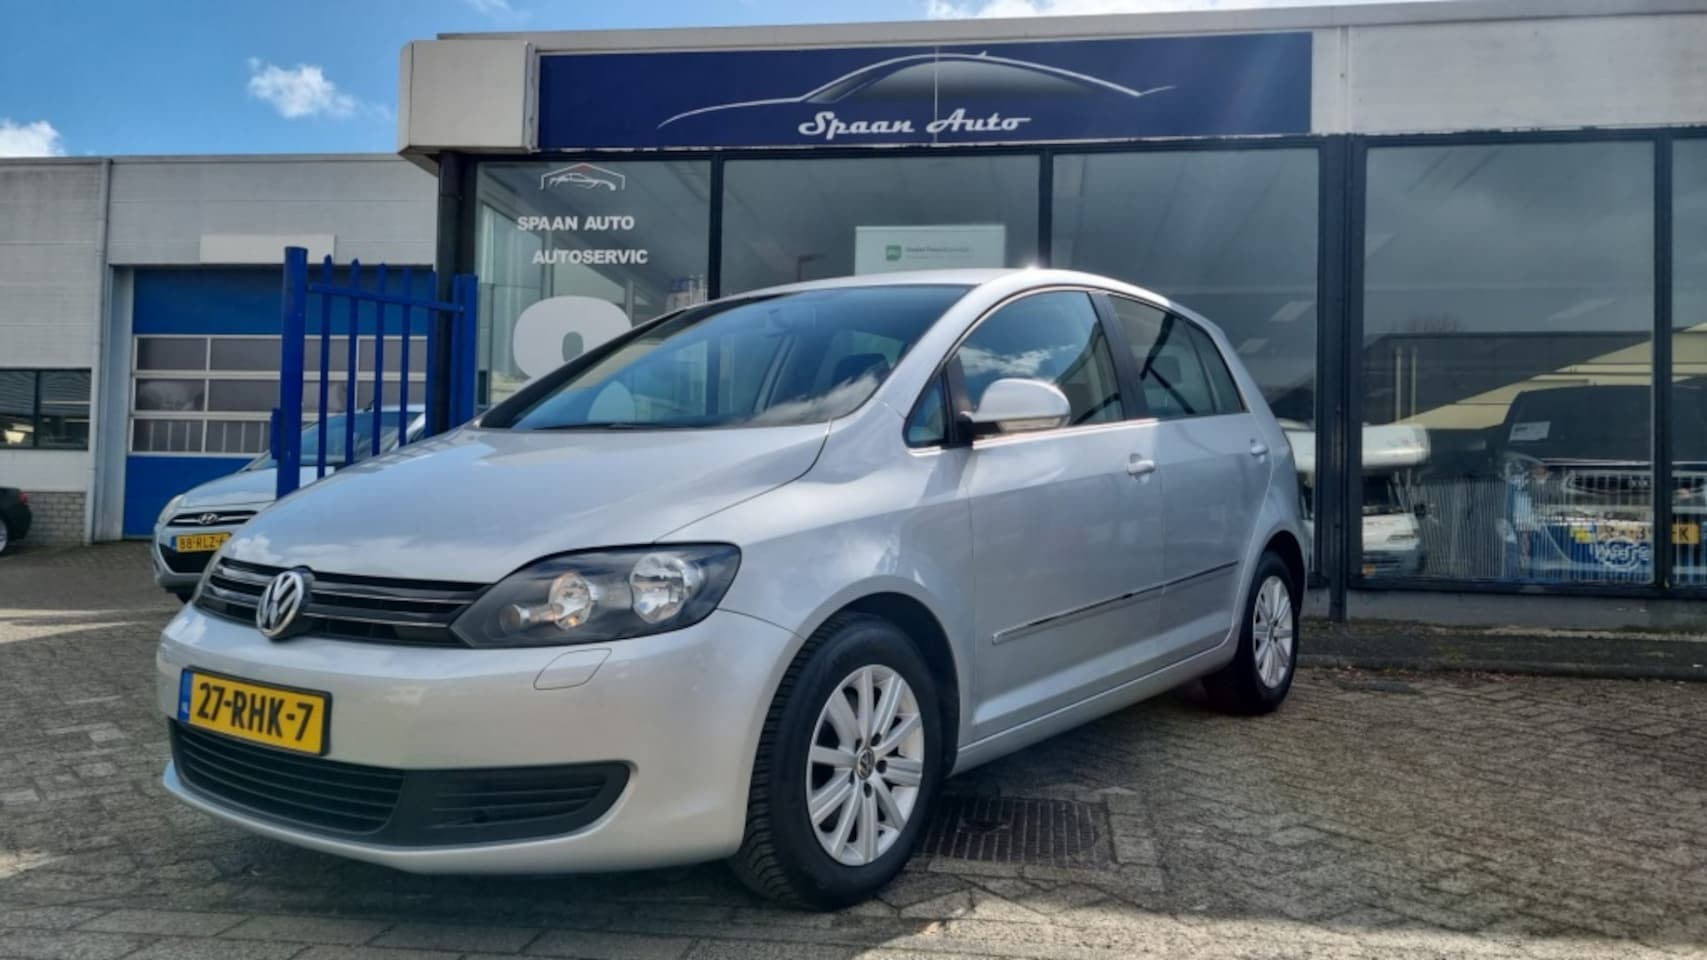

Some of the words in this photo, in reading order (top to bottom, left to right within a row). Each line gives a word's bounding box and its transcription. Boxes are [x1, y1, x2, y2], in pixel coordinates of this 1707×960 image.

[798, 110, 914, 140] Spaan
[926, 108, 1031, 132] Auto
[517, 215, 578, 231] SPAAN
[584, 215, 634, 230] AUTO
[532, 249, 648, 265] AUTOSERVIC
[197, 682, 314, 741] 27-RHK-7
